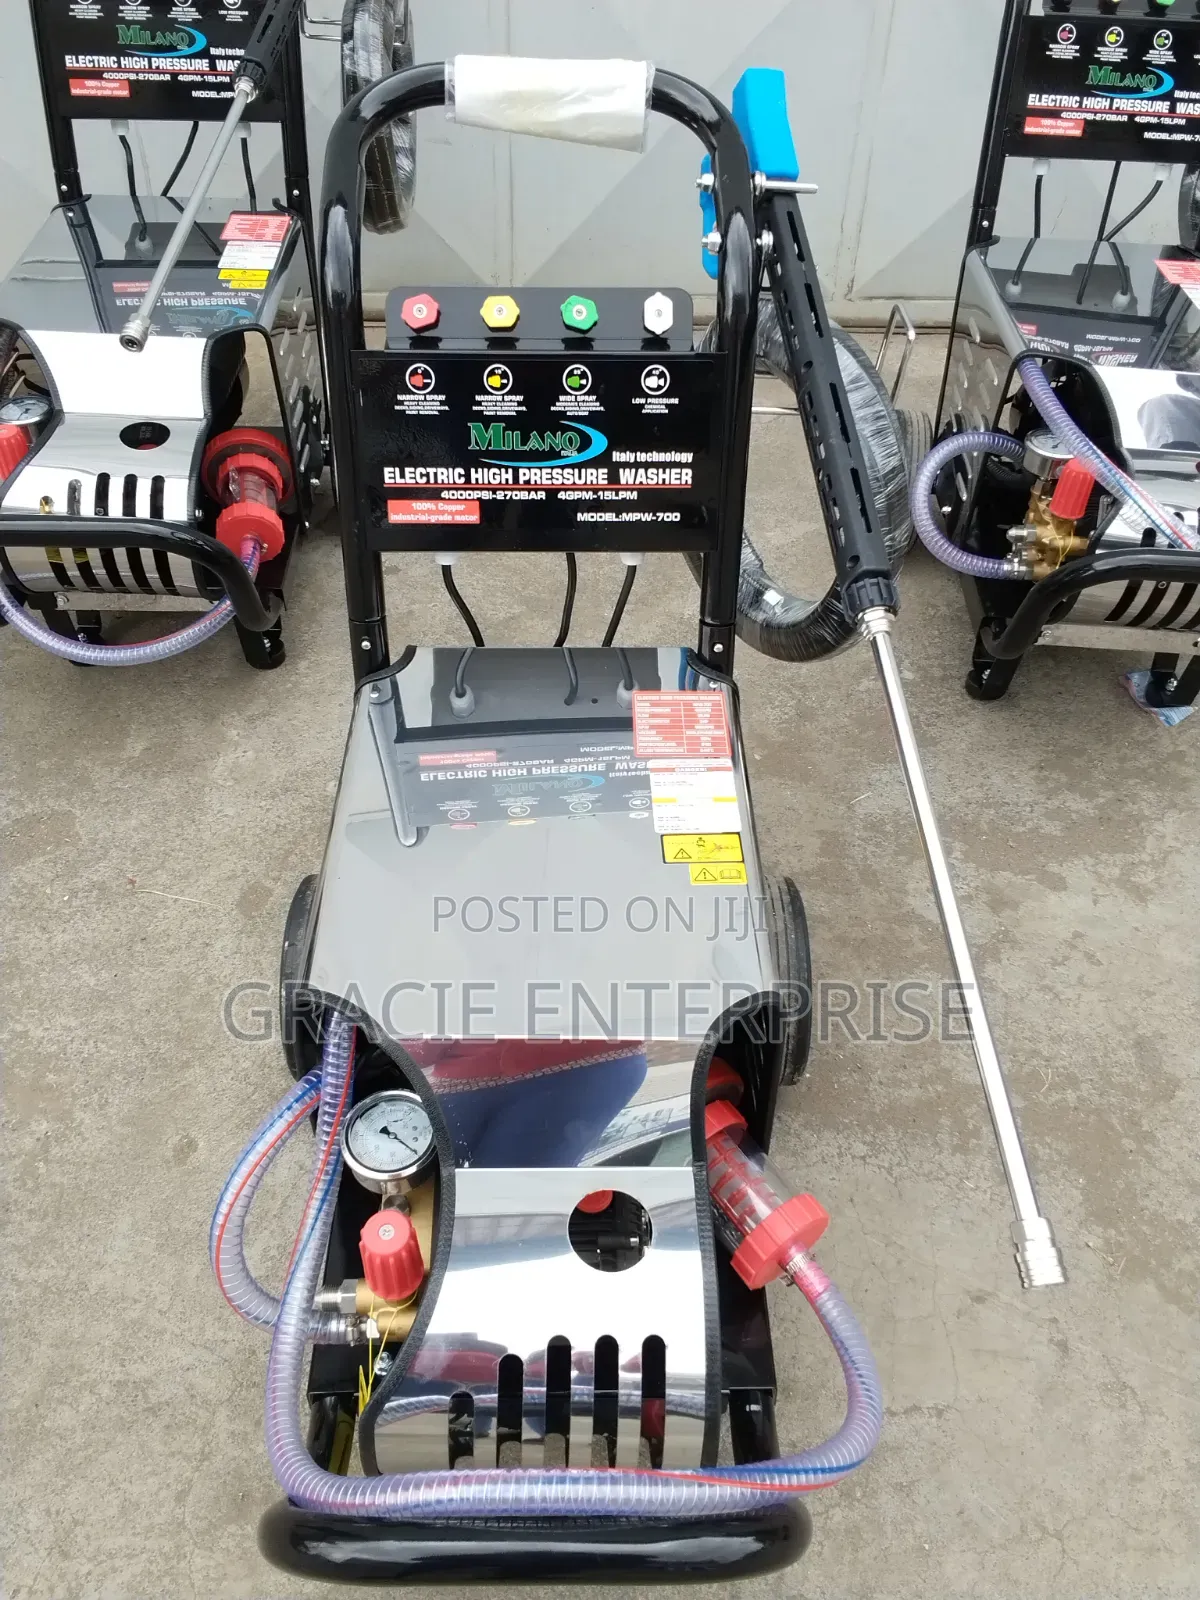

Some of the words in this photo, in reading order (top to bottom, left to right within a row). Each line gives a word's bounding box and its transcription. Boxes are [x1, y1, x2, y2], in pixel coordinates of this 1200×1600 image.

[116, 24, 189, 46] MILANO
[65, 55, 118, 68] ELECTRIC
[120, 56, 148, 69] HIGH
[152, 57, 210, 71] PRESSURE
[215, 59, 240, 71] WAS
[1085, 65, 1157, 88] MILANO
[1027, 93, 1080, 108] ELECTRIC
[1082, 96, 1111, 110] HIGH
[1112, 98, 1170, 113] PRESSURE
[1176, 102, 1200, 115] WAS
[1143, 131, 1200, 142] MODEL:MPW-7
[467, 422, 580, 452] MILANO
[612, 451, 634, 463] Italy
[636, 451, 693, 463] technology
[383, 467, 466, 484] ELECTRIC
[470, 467, 513, 485] HIGH
[519, 467, 608, 485] PRESSURE
[619, 468, 692, 485] WASHER
[441, 490, 546, 500] 4000PSI-270BAR
[557, 491, 638, 500] 4GPM-15LPM
[411, 503, 436, 511] 100%
[438, 503, 466, 512] Copper
[454, 514, 479, 522] motor
[577, 512, 681, 522] MODEL:MPW-700
